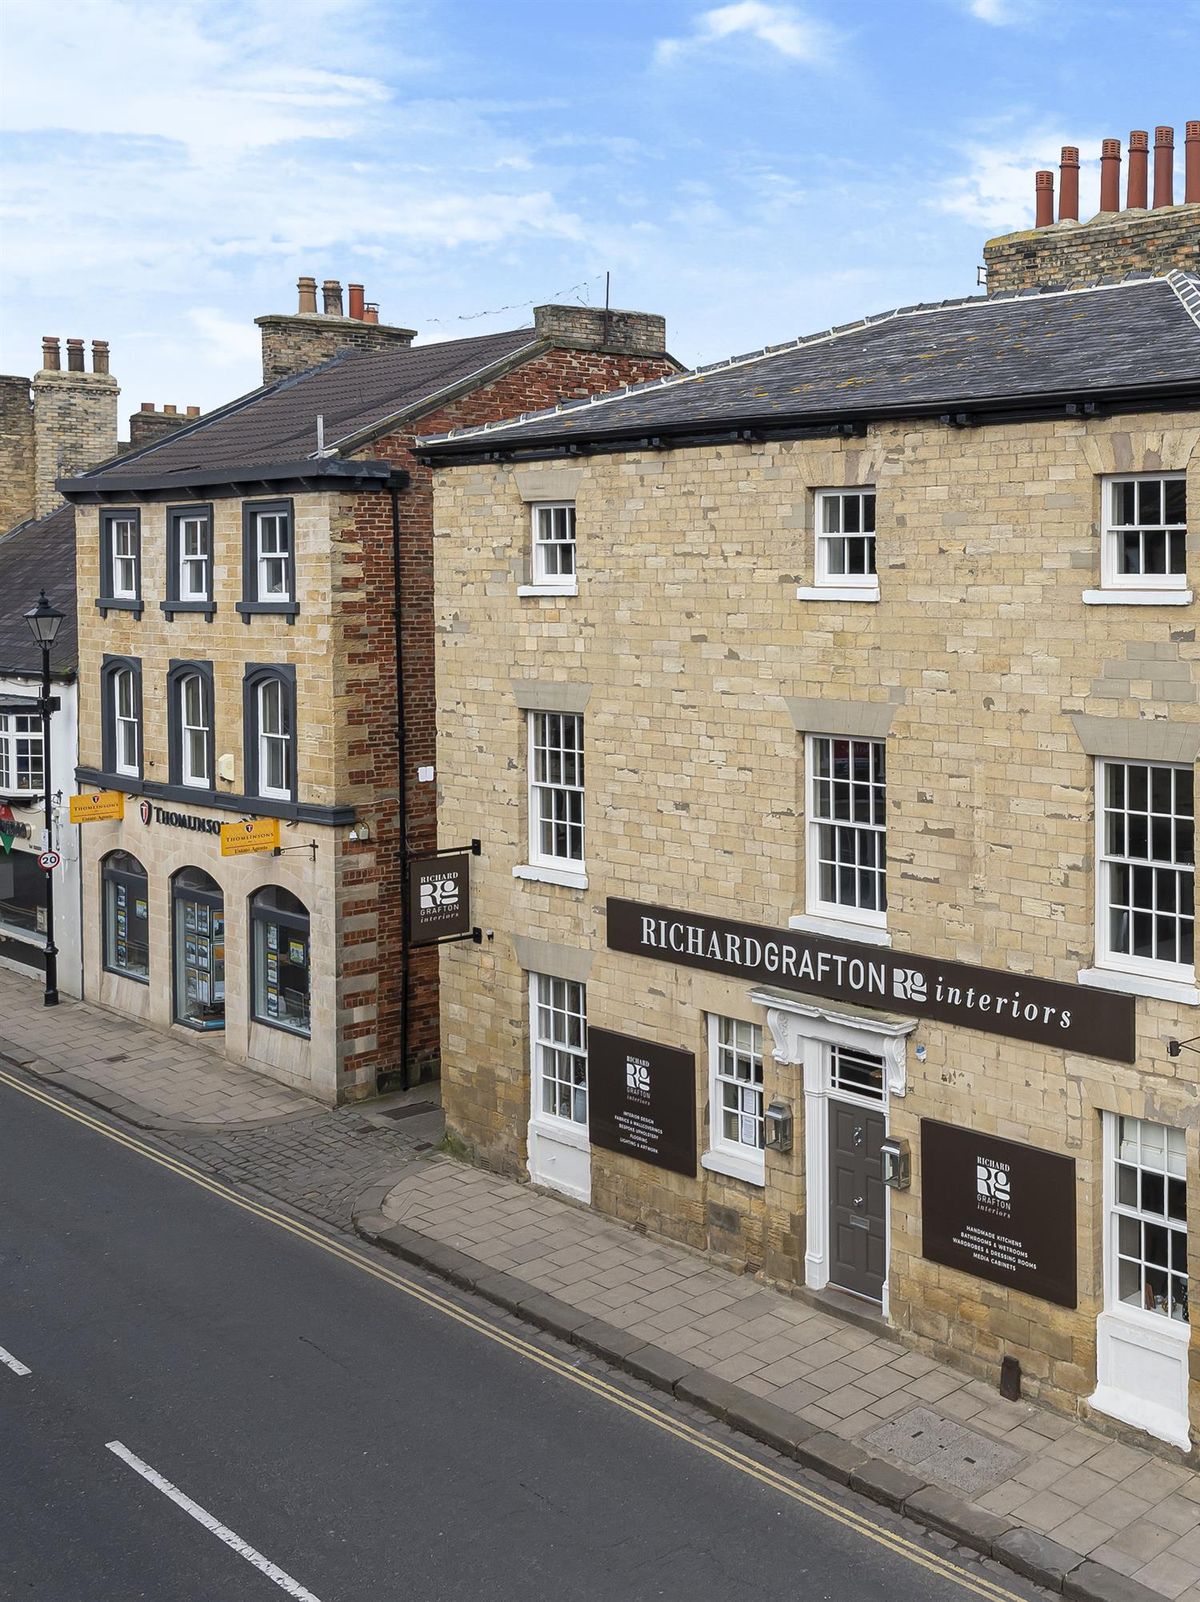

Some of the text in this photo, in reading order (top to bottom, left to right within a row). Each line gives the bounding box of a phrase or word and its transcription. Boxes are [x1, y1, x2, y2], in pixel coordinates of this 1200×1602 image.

[42, 855, 57, 865] 20
[420, 872, 459, 884] RICHARD
[420, 904, 460, 916] GRAFTON
[420, 913, 459, 924] interiors
[935, 976, 1072, 1029] interiors
[626, 1055, 650, 1068] RICHARD
[626, 1086, 651, 1099] GRAFTON
[976, 1155, 1010, 1172] RICHARD
[976, 1193, 1011, 1211] GRAFTON
[977, 1202, 1011, 1219] interiors
[960, 1231, 992, 1247] BATHROOMS
[998, 1244, 1028, 1259] WETROOMS
[966, 1225, 1022, 1248] HANDMADE KITCHENS
[952, 1237, 984, 1253] WARDROBES
[990, 1249, 1017, 1264] DRESSING
[1017, 1258, 1037, 1270] ROOMS
[973, 1252, 1017, 1272] MEDIA CABINETS
